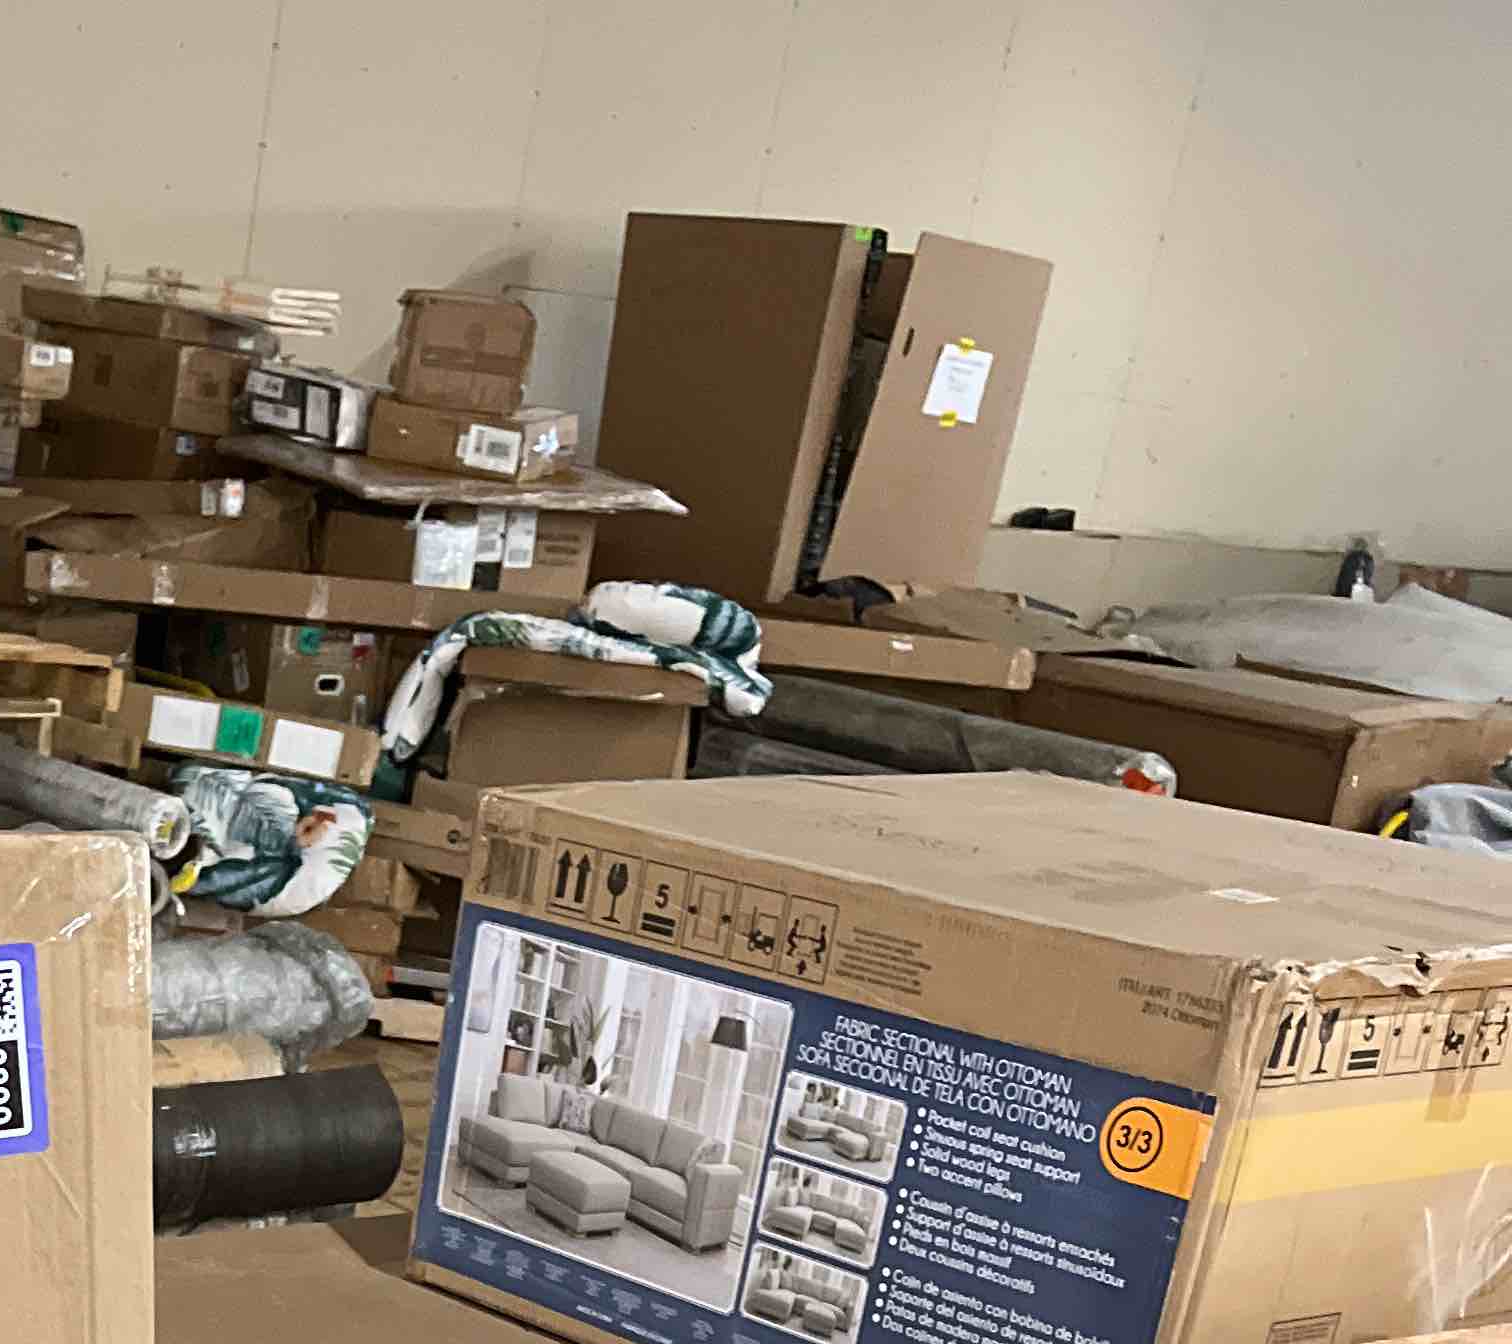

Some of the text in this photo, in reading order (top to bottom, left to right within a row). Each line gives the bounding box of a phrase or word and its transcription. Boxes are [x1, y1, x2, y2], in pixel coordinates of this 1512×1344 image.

[655, 884, 670, 909] 5
[1364, 1014, 1376, 1042] 5
[819, 1031, 1081, 1118] SECTIONNEL EN TISSU AVEC OTTOMAN
[835, 1016, 1072, 1094] FABRIC SECTIONAL WITH OTTOMAN
[796, 1044, 1096, 1143] SOFA SECCIONAL DE TELA CON OTTOMANO
[928, 1109, 1066, 1162] Pocket coil seat cushion
[1116, 1124, 1153, 1154] 3/3
[918, 1157, 1023, 1203] Two accent pillows
[920, 1142, 1011, 1182] Solid wood legs
[968, 1143, 1004, 1164] spring
[1005, 1152, 1032, 1170] seat
[1033, 1162, 1081, 1185] support
[899, 1237, 927, 1259] Deux
[903, 1221, 1012, 1269] Pieds en bois massif
[906, 1206, 951, 1232] Support
[1010, 1243, 1054, 1266] ressorts
[1012, 1226, 1056, 1249] ressorts
[881, 1314, 904, 1334] Dos
[886, 1300, 916, 1322] Patas
[917, 1312, 935, 1328] de
[936, 1319, 980, 1344] madera
[889, 1284, 934, 1311] Soporte
[935, 1301, 956, 1318] del
[956, 1311, 999, 1334] asiento
[1000, 1324, 1018, 1340] de
[923, 1280, 940, 1296] de
[941, 1288, 983, 1312] asiento
[985, 1303, 1009, 1319] con
[1009, 1308, 1053, 1336] bobina
[1055, 1325, 1073, 1342] de
